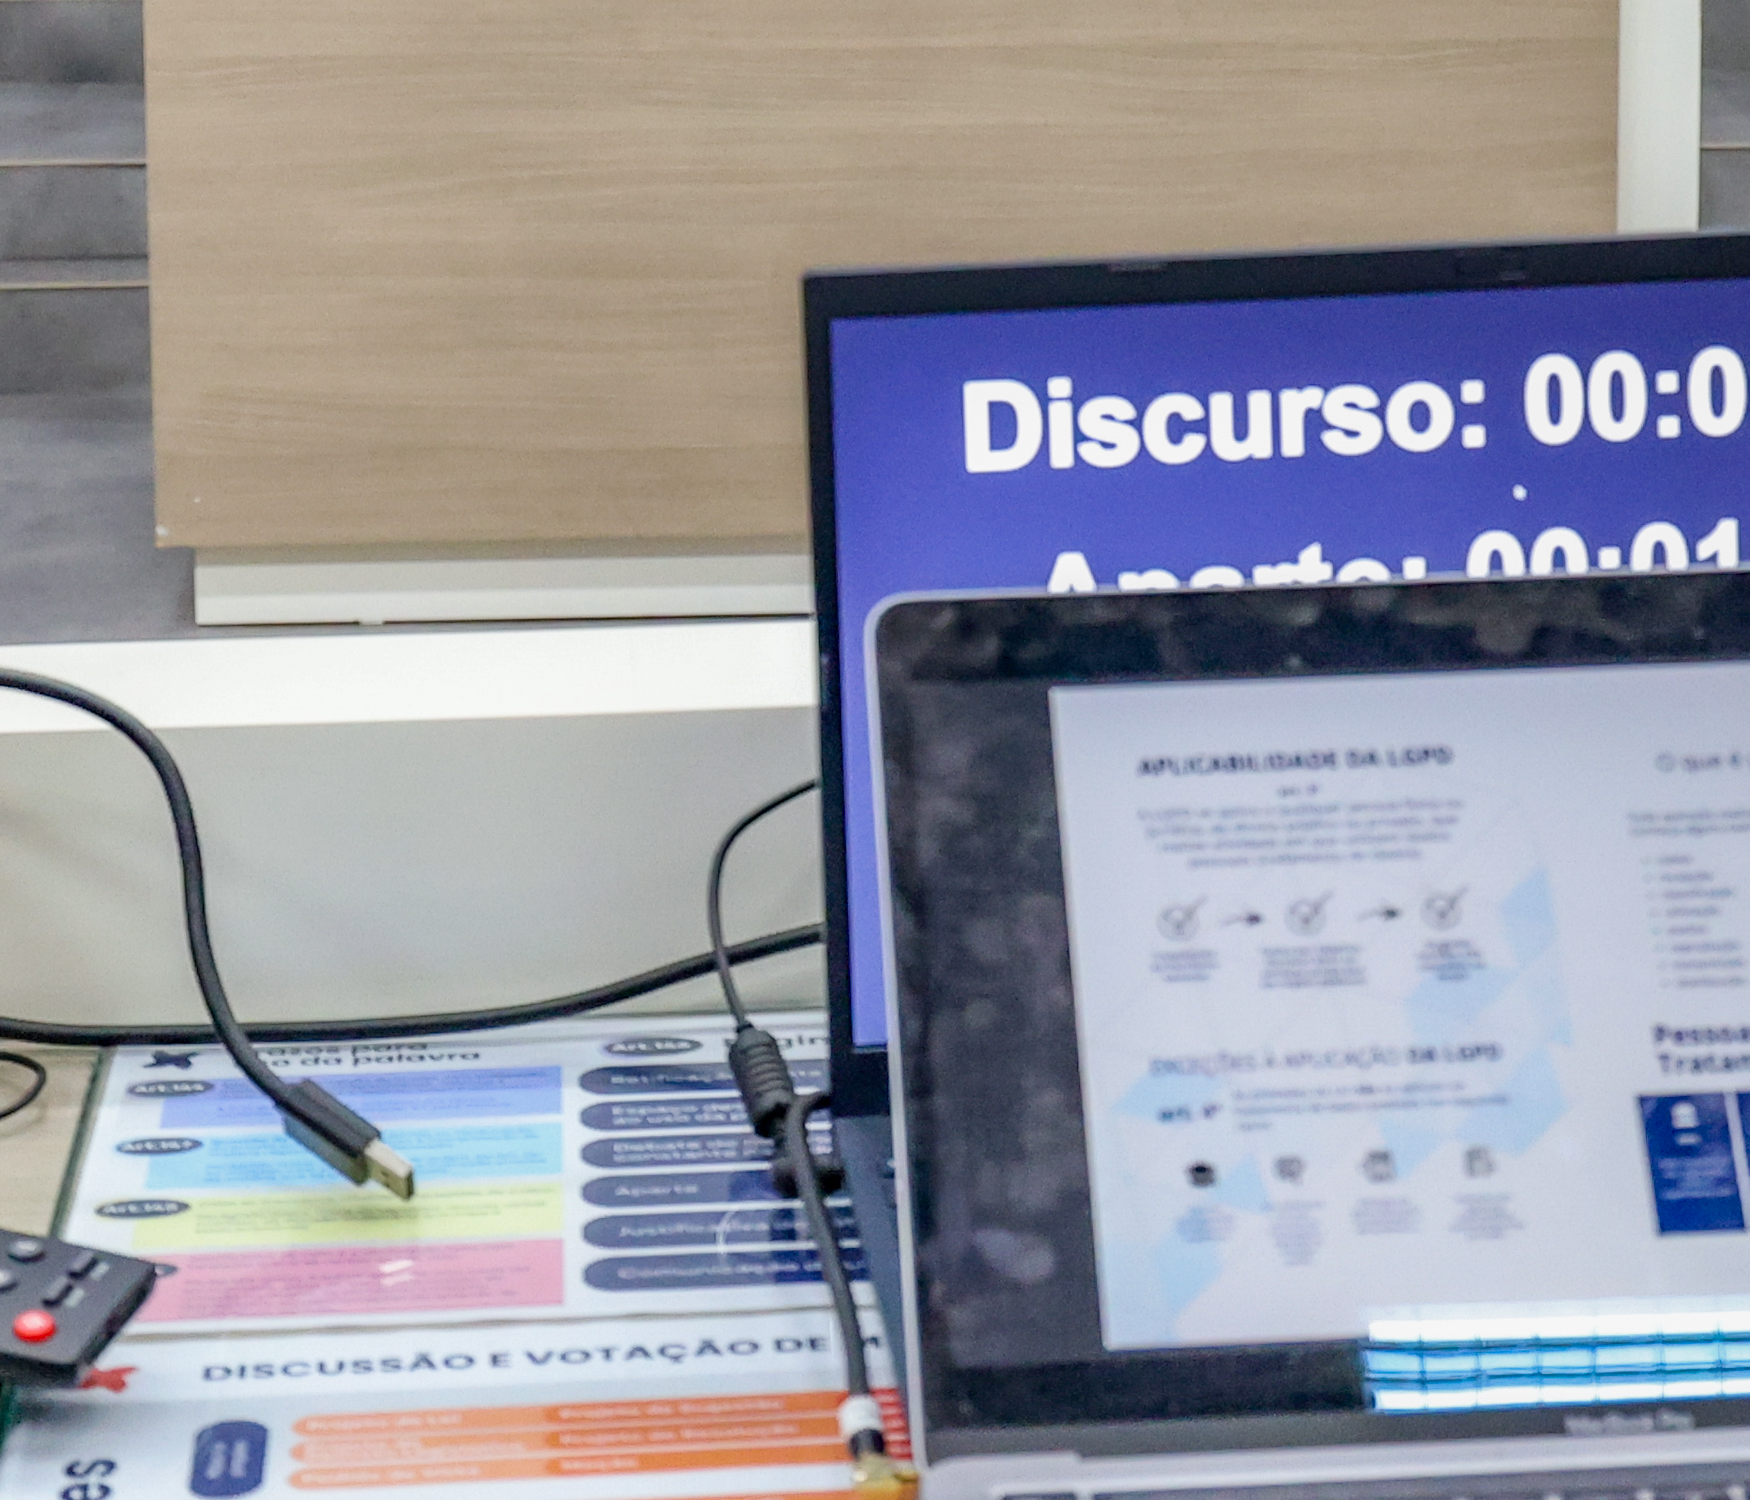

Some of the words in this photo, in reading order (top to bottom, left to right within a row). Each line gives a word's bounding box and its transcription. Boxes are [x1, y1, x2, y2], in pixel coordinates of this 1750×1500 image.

[963, 376, 1487, 474] Discurso:
[1136, 749, 1338, 778] APLICABILIDADE
[1346, 748, 1379, 770] DA
[1387, 743, 1454, 768] LGPD
[1681, 752, 1722, 773] que
[351, 1049, 482, 1068] palavra
[1406, 1042, 1437, 1066] DA
[1444, 1040, 1504, 1065] LGPD
[202, 1350, 476, 1381] DISCUSSÃO
[490, 1352, 511, 1368] E
[525, 1338, 760, 1366] VOTAÇÃO
[774, 1337, 827, 1353] DE
